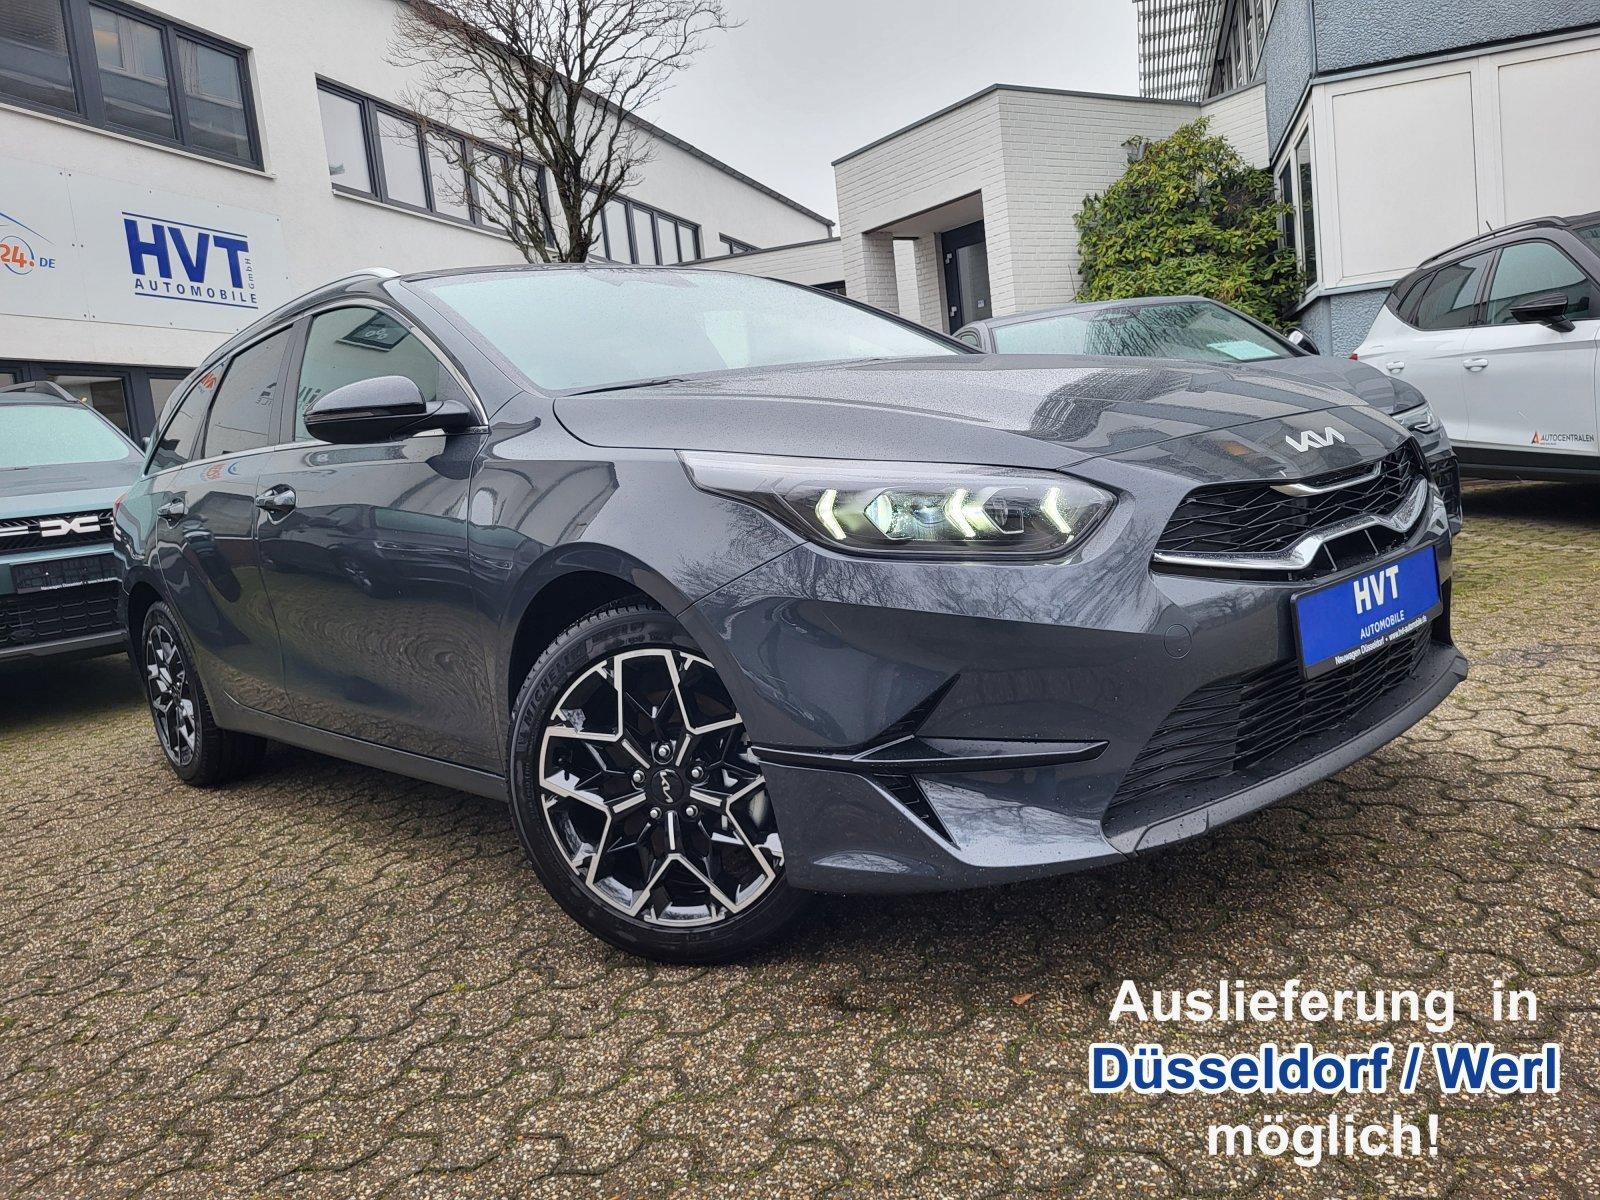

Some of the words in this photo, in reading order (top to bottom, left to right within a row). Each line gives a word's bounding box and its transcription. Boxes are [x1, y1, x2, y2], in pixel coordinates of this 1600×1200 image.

[123, 218, 249, 290] HVT
[244, 257, 255, 290] GmbH
[134, 278, 258, 304] AUTOMOBILE
[1540, 433, 1595, 443] AUTOCENTRALEN
[1353, 564, 1399, 615] HVT
[1359, 609, 1405, 640] AUTOMOBILE
[1334, 647, 1362, 665] Neuwagen
